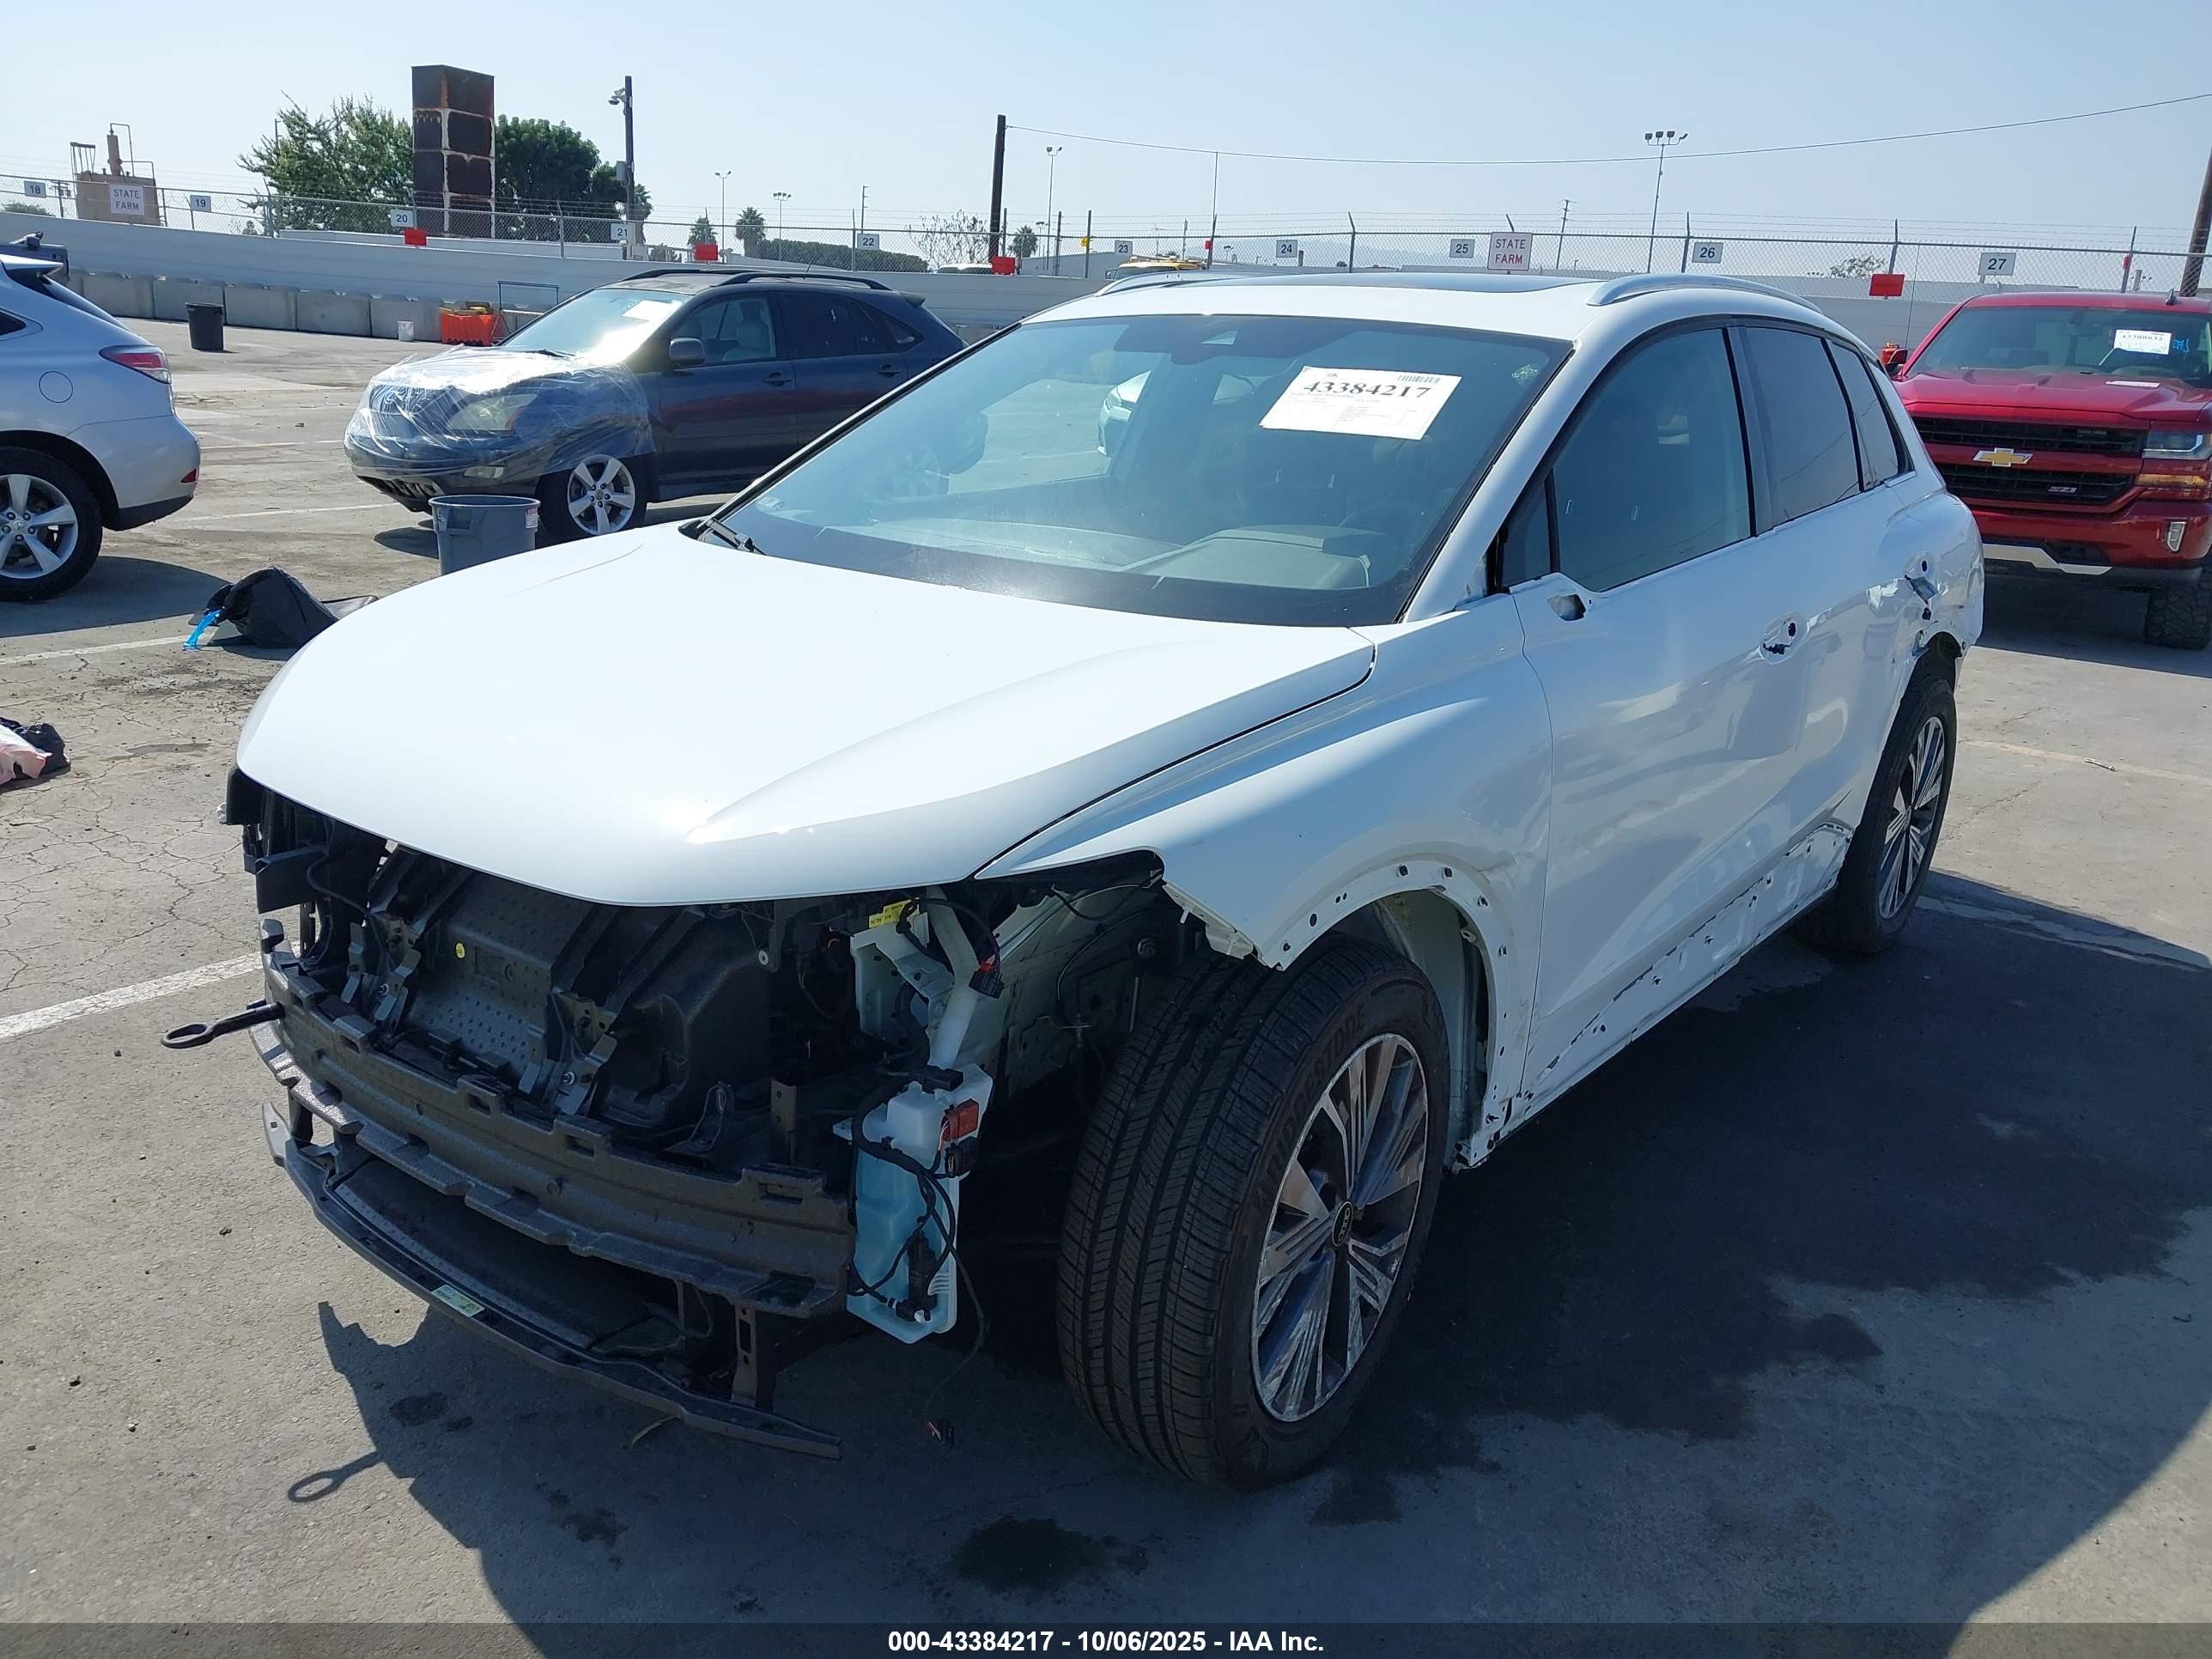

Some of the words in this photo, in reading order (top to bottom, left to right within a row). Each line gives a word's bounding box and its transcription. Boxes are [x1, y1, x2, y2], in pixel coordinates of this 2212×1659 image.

[30, 185, 41, 194] 18
[113, 189, 139, 198] STATE
[115, 201, 139, 210] FARM
[197, 198, 206, 207] 19
[396, 214, 408, 222] 20
[617, 228, 628, 237] 21
[862, 237, 874, 246] 22
[1495, 239, 1527, 249] STATE
[1118, 244, 1128, 253] 23
[1280, 244, 1292, 253] 24
[1455, 243, 1468, 254] 25
[1699, 246, 1716, 258] 26
[1495, 253, 1524, 264] FARM
[1987, 258, 2007, 270] 27
[1304, 381, 1431, 398] 43384217
